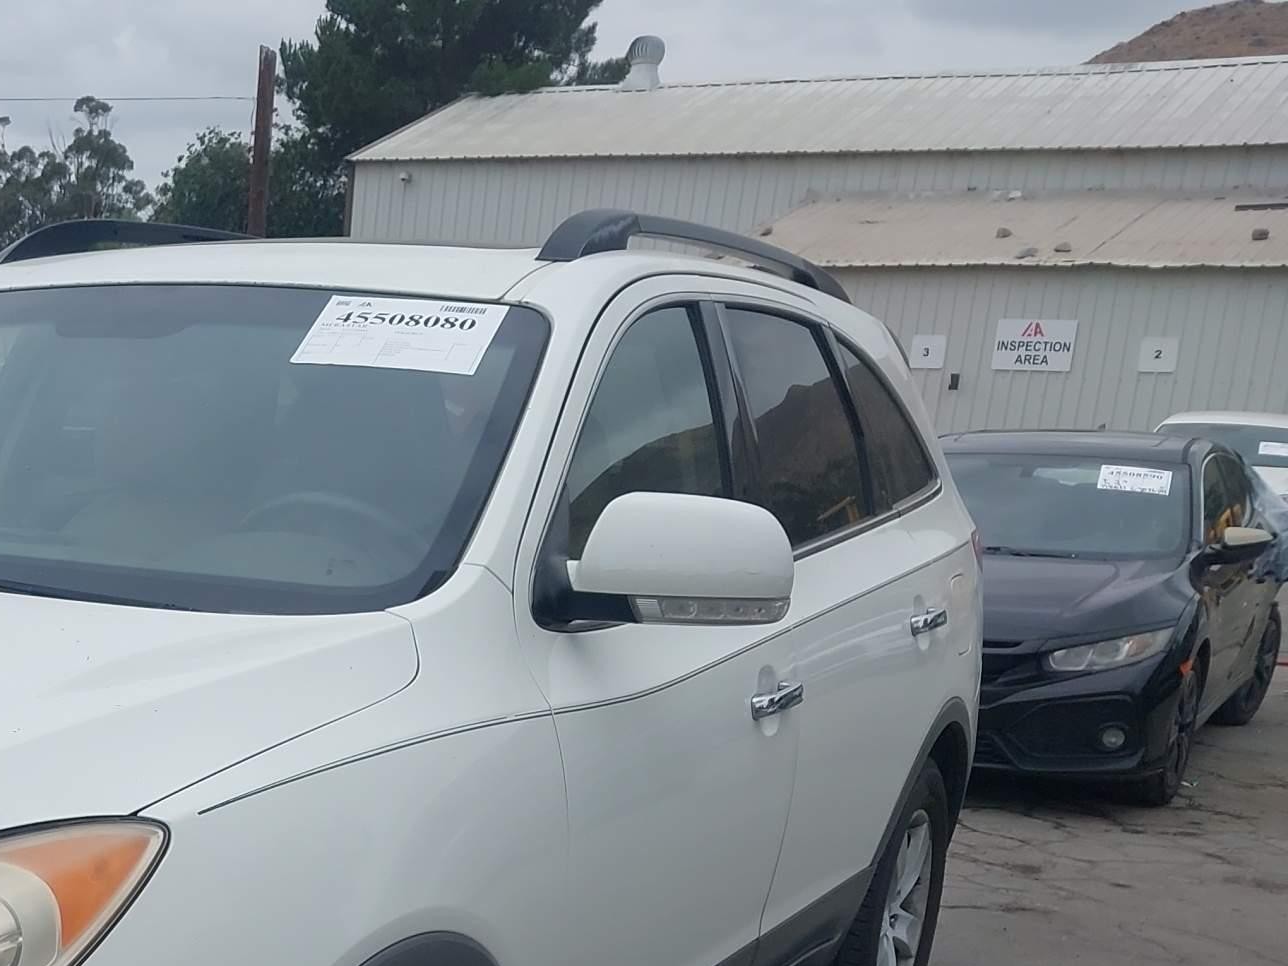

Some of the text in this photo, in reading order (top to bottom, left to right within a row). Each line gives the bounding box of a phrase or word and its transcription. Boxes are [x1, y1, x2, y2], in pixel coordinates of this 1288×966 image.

[335, 311, 477, 331] 45508080
[996, 340, 1071, 352] INSPECTION
[922, 347, 930, 357] 3
[1154, 349, 1162, 359] 2
[1014, 354, 1049, 365] AREA
